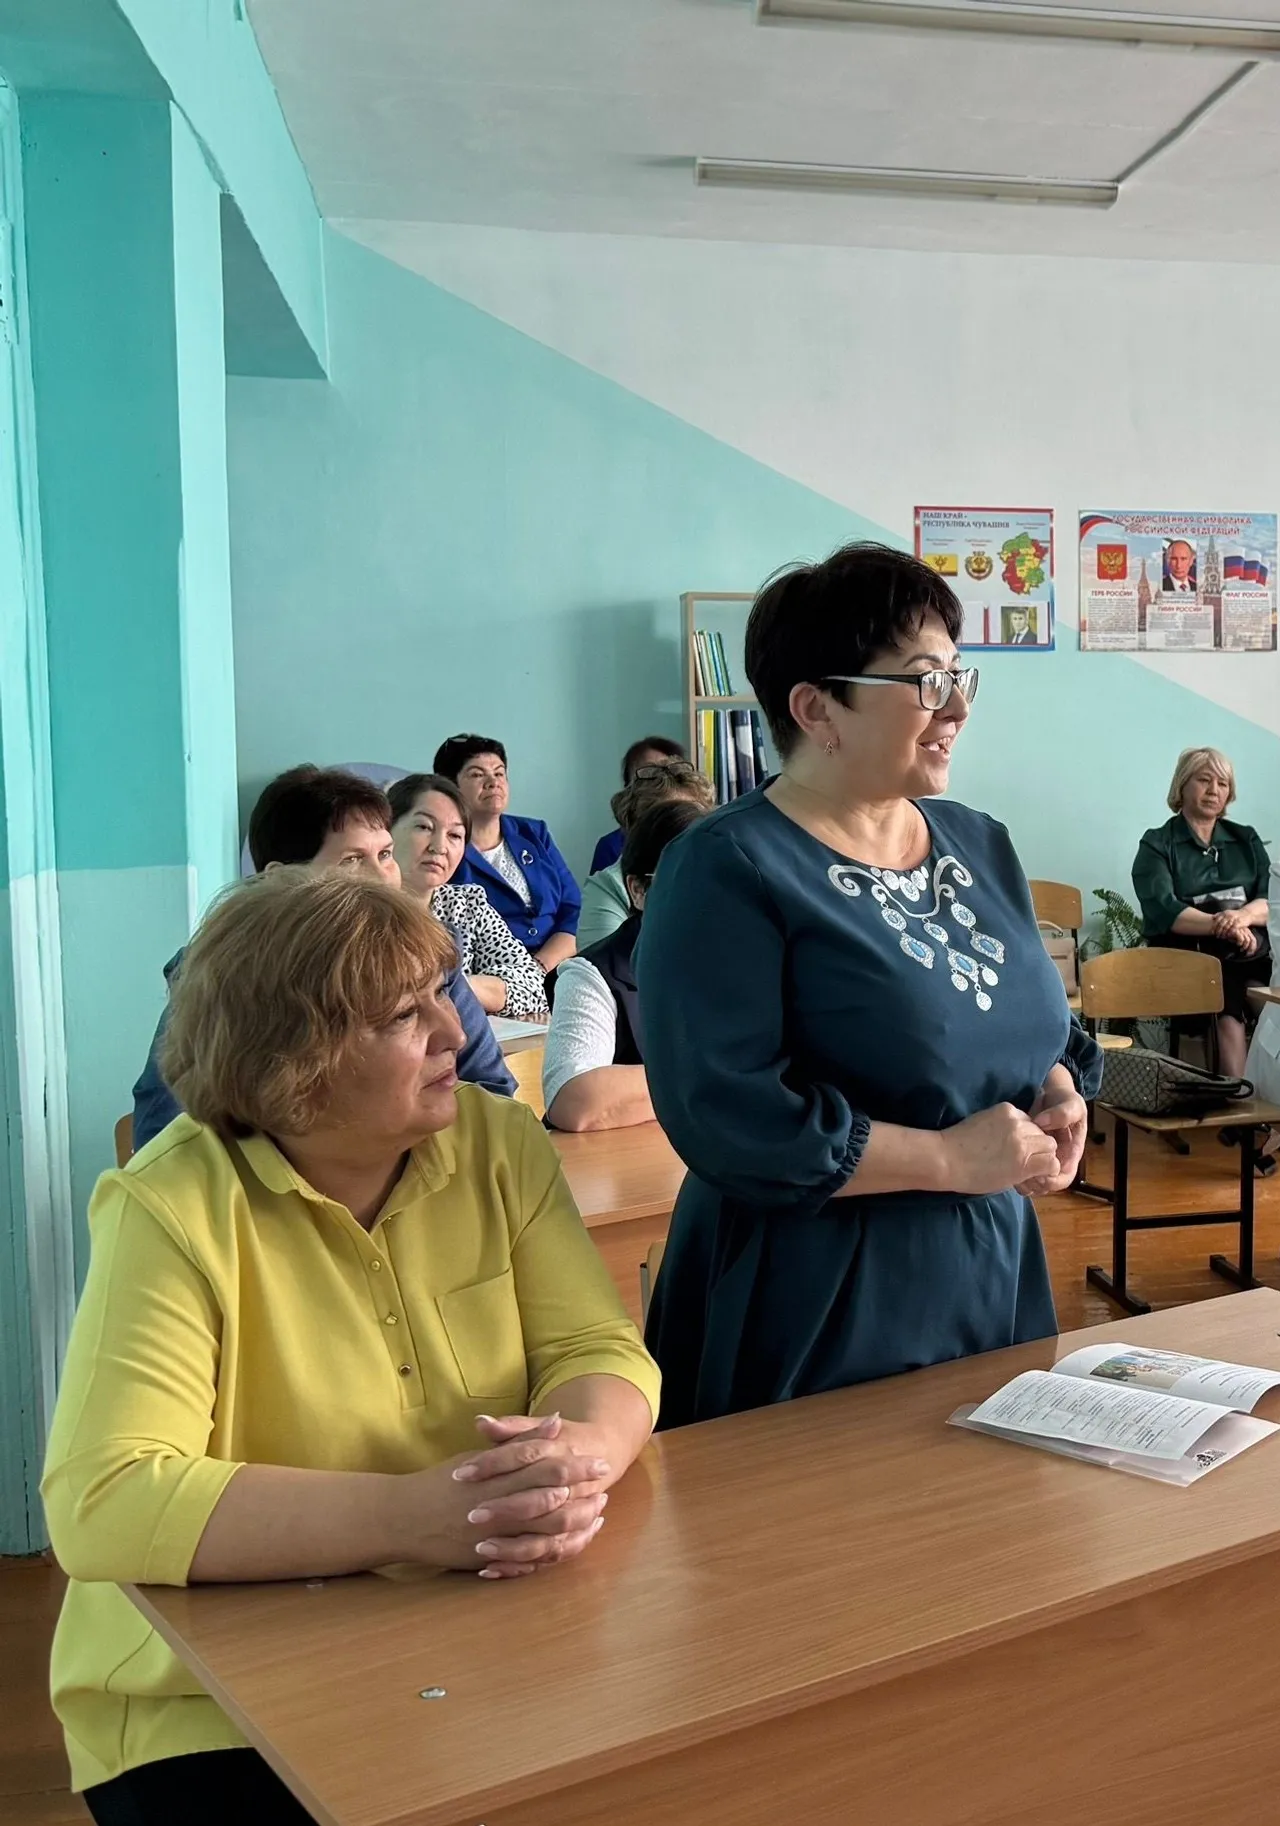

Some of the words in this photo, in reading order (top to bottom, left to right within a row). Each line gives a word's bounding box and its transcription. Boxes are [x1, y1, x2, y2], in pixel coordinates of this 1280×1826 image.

[922, 520, 971, 528] РЕСПУБЛИКА
[1107, 589, 1133, 598] РОССИИ
[1176, 605, 1202, 613] РОССИИ
